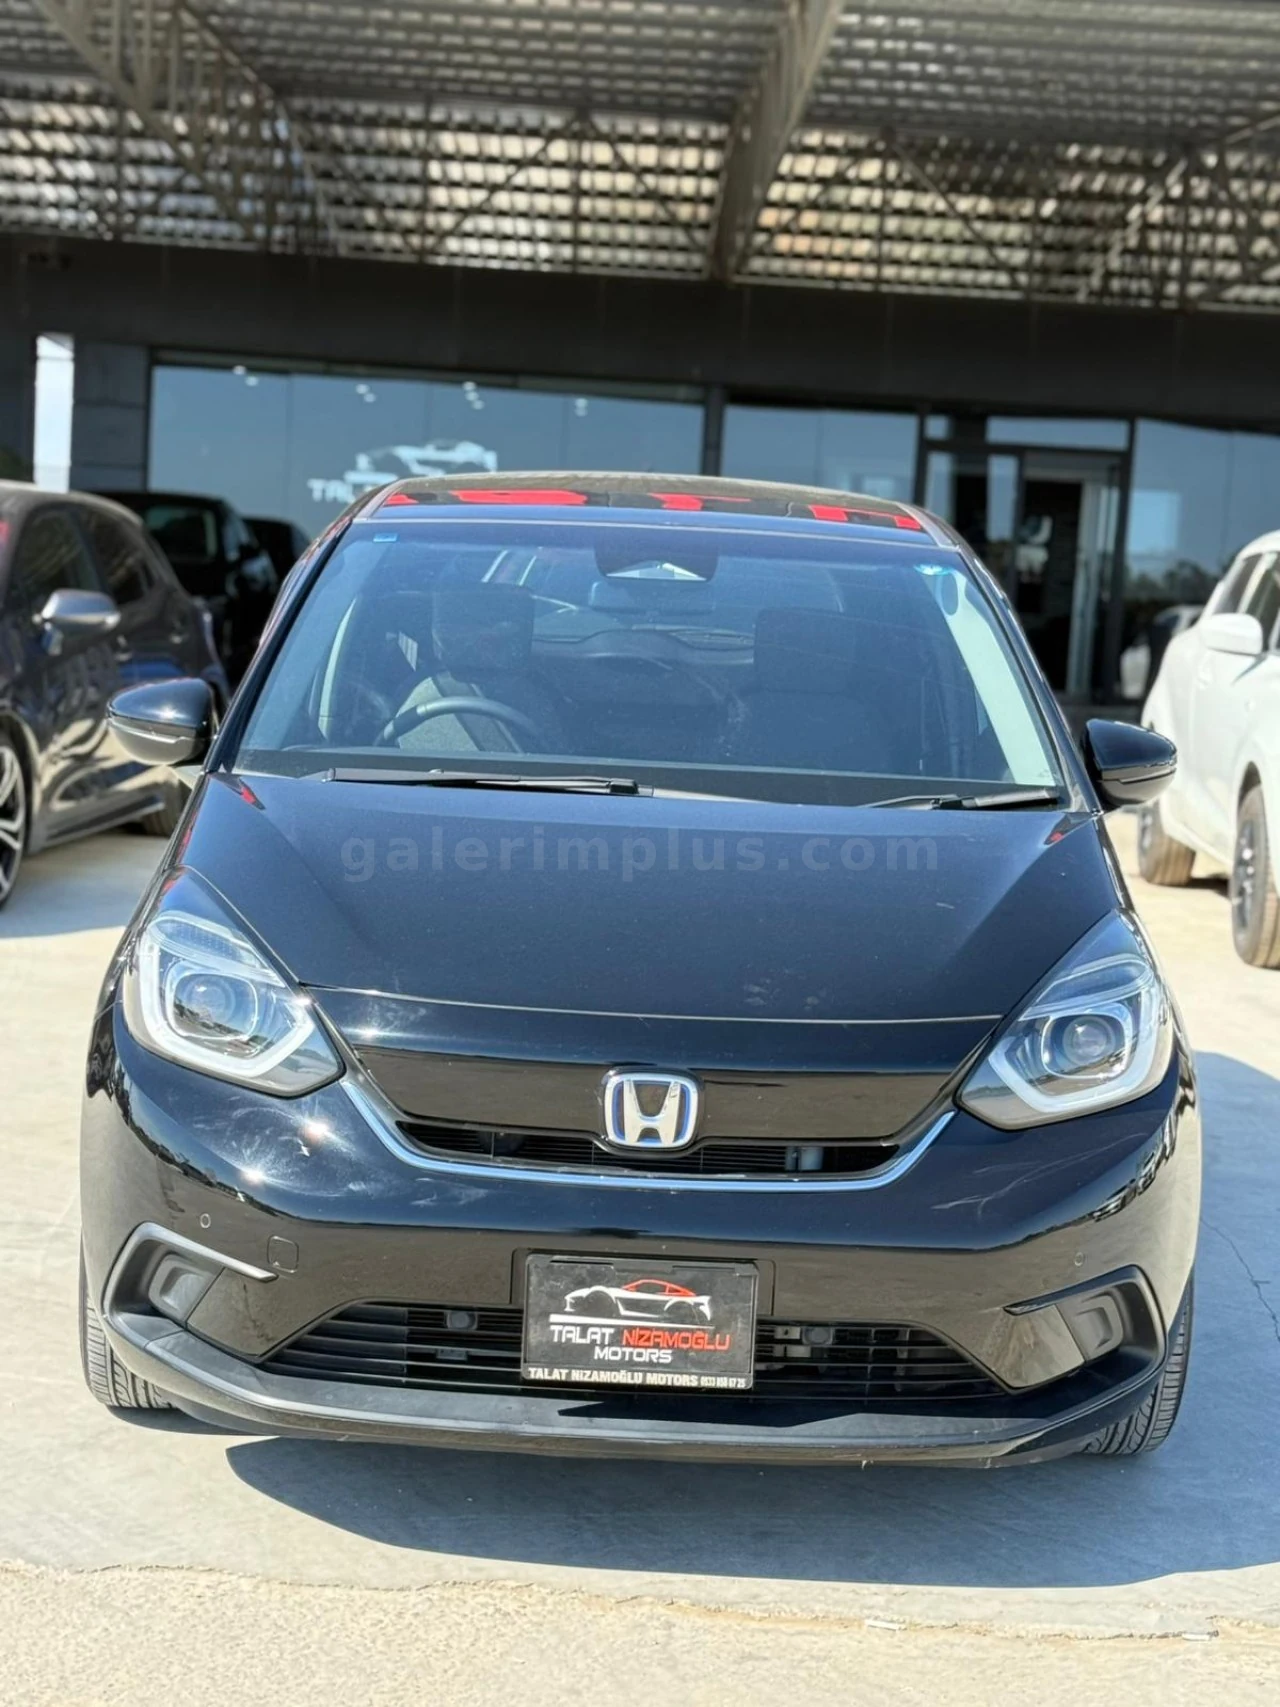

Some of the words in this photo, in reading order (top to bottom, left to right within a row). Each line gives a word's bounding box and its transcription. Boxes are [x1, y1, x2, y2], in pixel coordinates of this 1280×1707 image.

[550, 1324, 615, 1345] TALAT
[593, 1346, 673, 1364] MOTORS
[528, 1367, 569, 1381] TALAT
[646, 1372, 698, 1387] MOTORS
